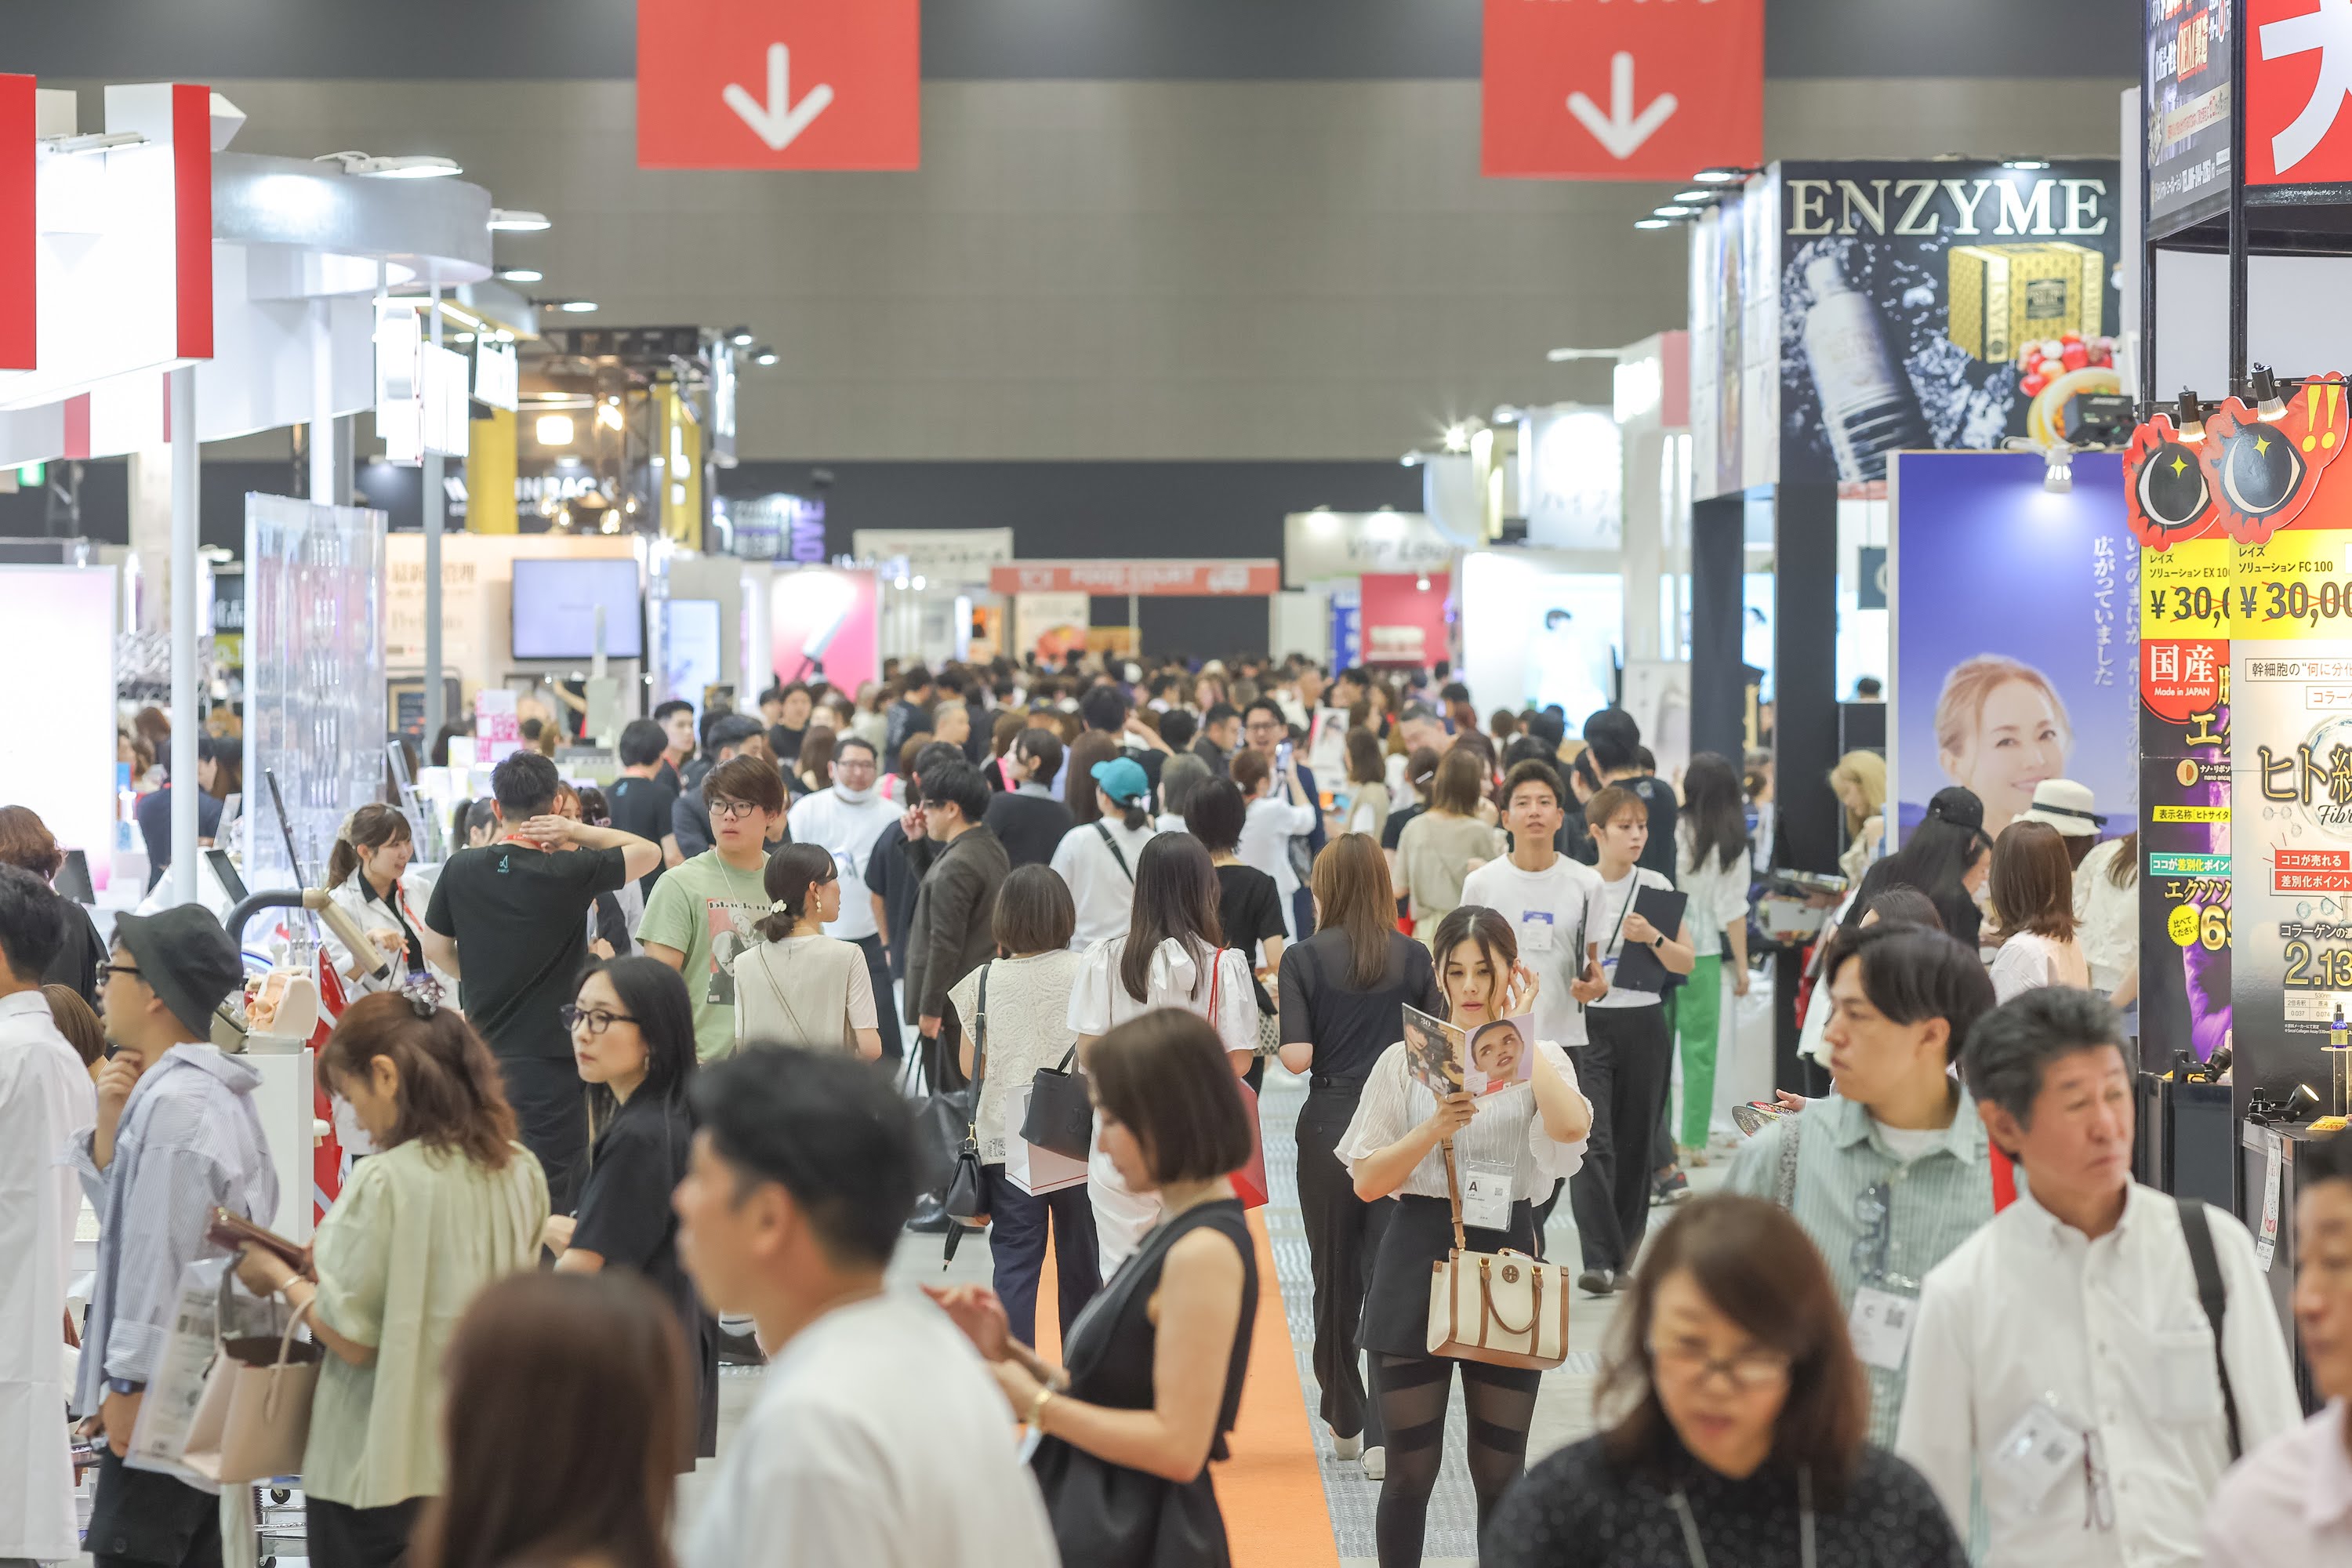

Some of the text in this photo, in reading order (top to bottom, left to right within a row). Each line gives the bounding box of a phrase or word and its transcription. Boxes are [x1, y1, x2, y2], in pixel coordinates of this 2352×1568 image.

[1786, 179, 2109, 236] ENZYME
[2239, 546, 2265, 557] レイズ
[2150, 554, 2173, 564] レイズ
[2150, 568, 2201, 578] ソリューション
[2204, 568, 2215, 578] EX
[2239, 561, 2333, 573] ソリューション FC 100
[2093, 535, 2116, 686] 広がっていました
[2151, 644, 2215, 683] 国産
[2154, 687, 2211, 696] Made in JAPAN
[2281, 855, 2342, 867] ココが売れる
[2281, 875, 2351, 888] 差別化ポイント
[1468, 1181, 1478, 1192] A
